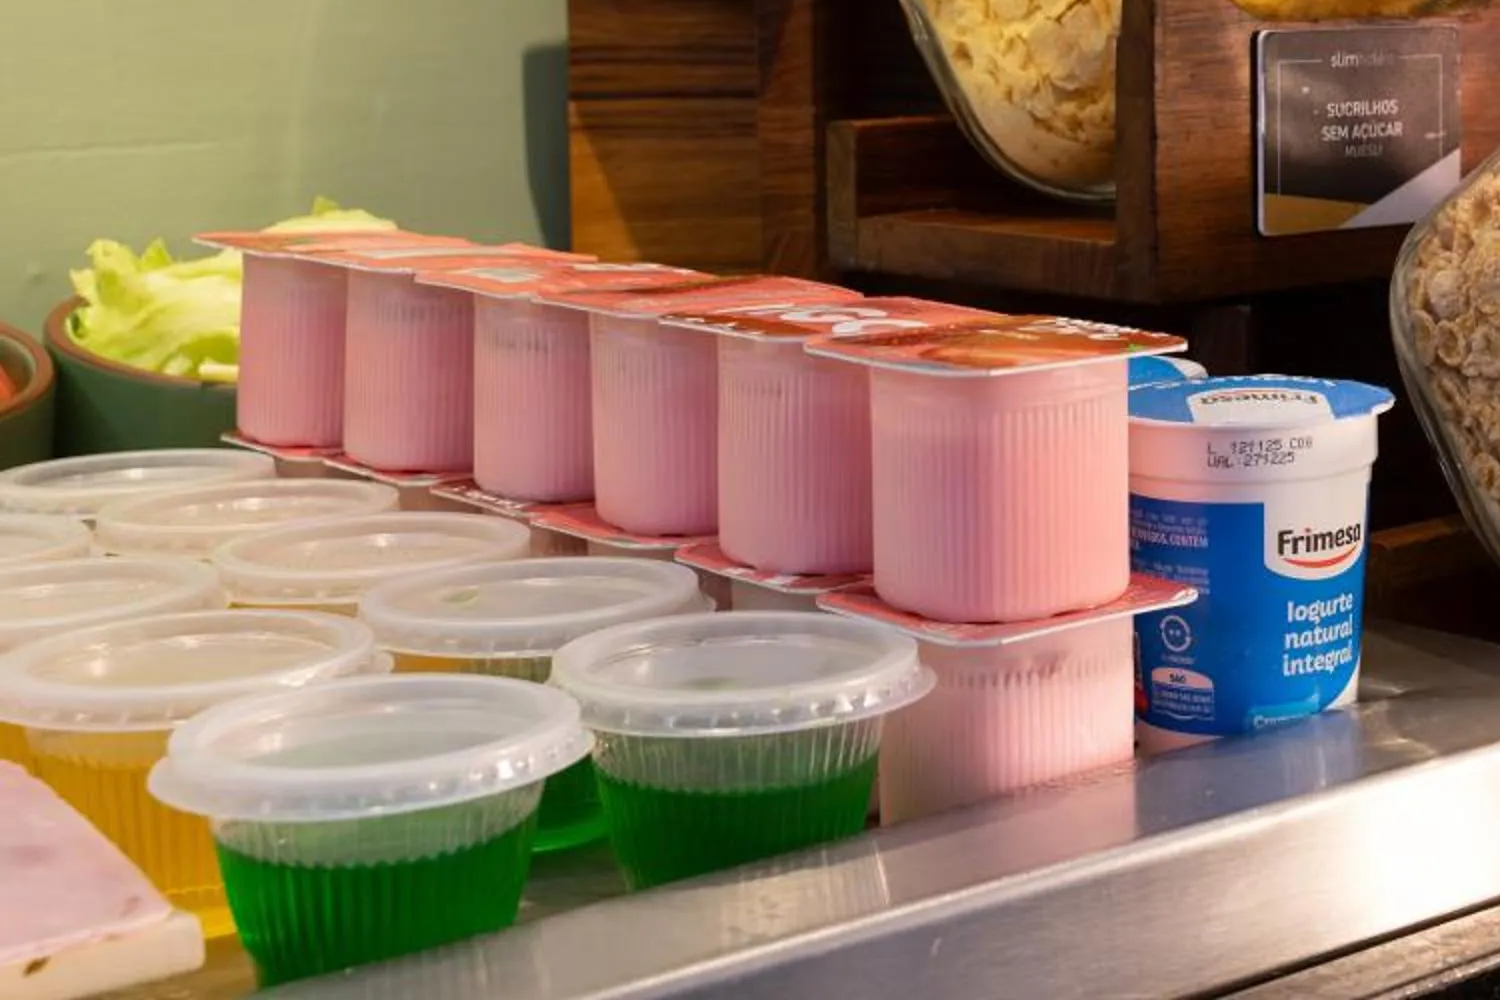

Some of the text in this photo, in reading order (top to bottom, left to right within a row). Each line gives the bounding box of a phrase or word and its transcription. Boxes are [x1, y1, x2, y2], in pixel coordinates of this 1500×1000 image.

[1327, 99, 1399, 118] SUCRILHOS
[1321, 124, 1349, 142] SEM
[1277, 523, 1361, 556] Frimesa
[1284, 614, 1353, 649] natural
[1282, 639, 1353, 677] integral
